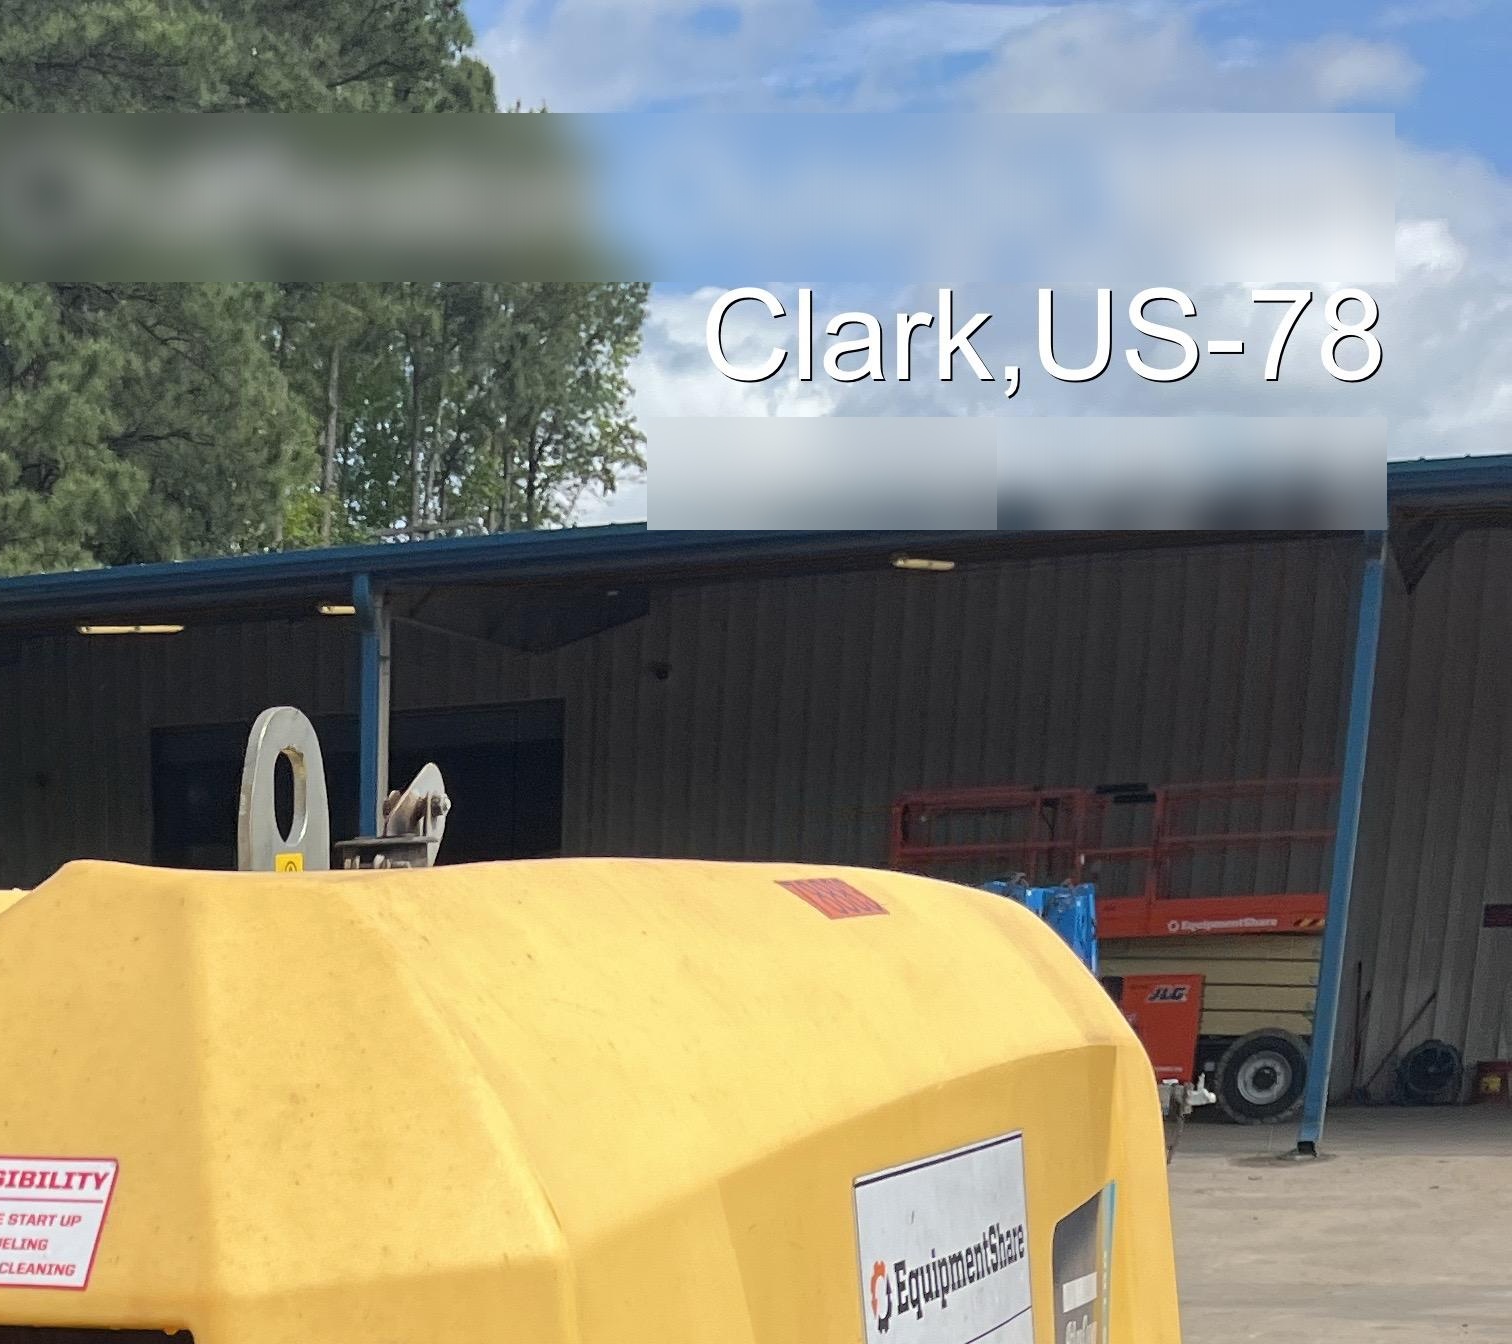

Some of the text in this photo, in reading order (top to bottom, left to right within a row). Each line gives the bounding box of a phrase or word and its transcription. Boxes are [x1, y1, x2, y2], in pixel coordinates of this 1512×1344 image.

[7, 1213, 57, 1227] START
[59, 1215, 82, 1228] UP
[894, 1223, 1025, 1320] EquipmentShare
